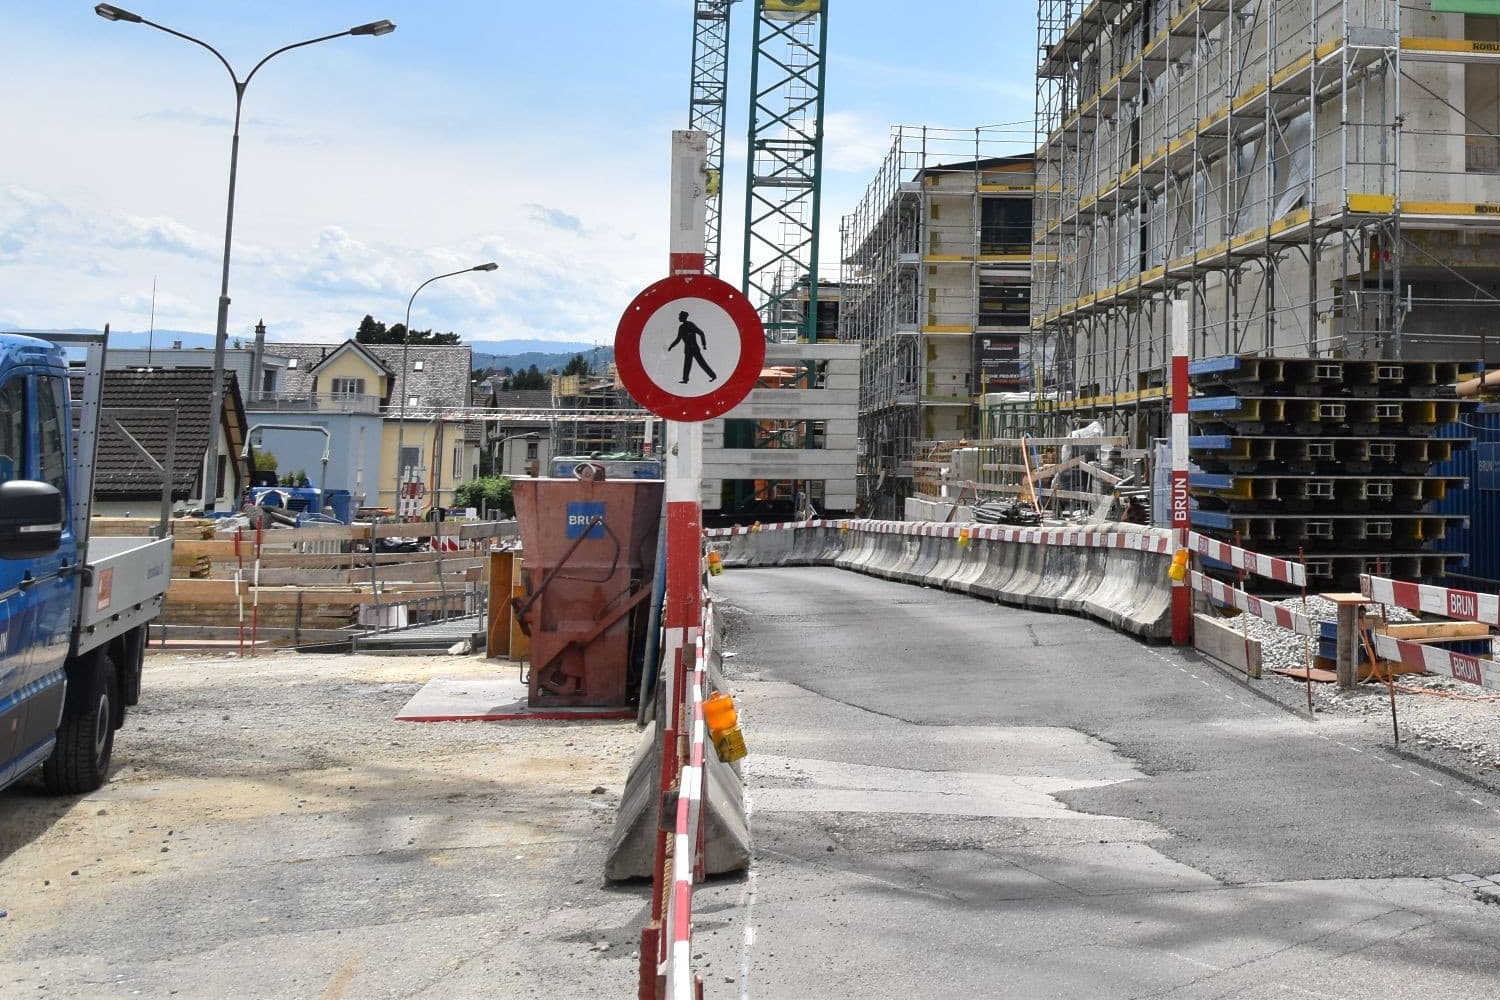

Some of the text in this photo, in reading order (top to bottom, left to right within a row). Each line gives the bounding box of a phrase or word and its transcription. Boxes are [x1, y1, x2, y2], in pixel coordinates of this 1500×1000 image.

[1174, 478, 1187, 521] BRUN
[1450, 593, 1474, 617] BRUN
[1452, 657, 1478, 681] BRUN
